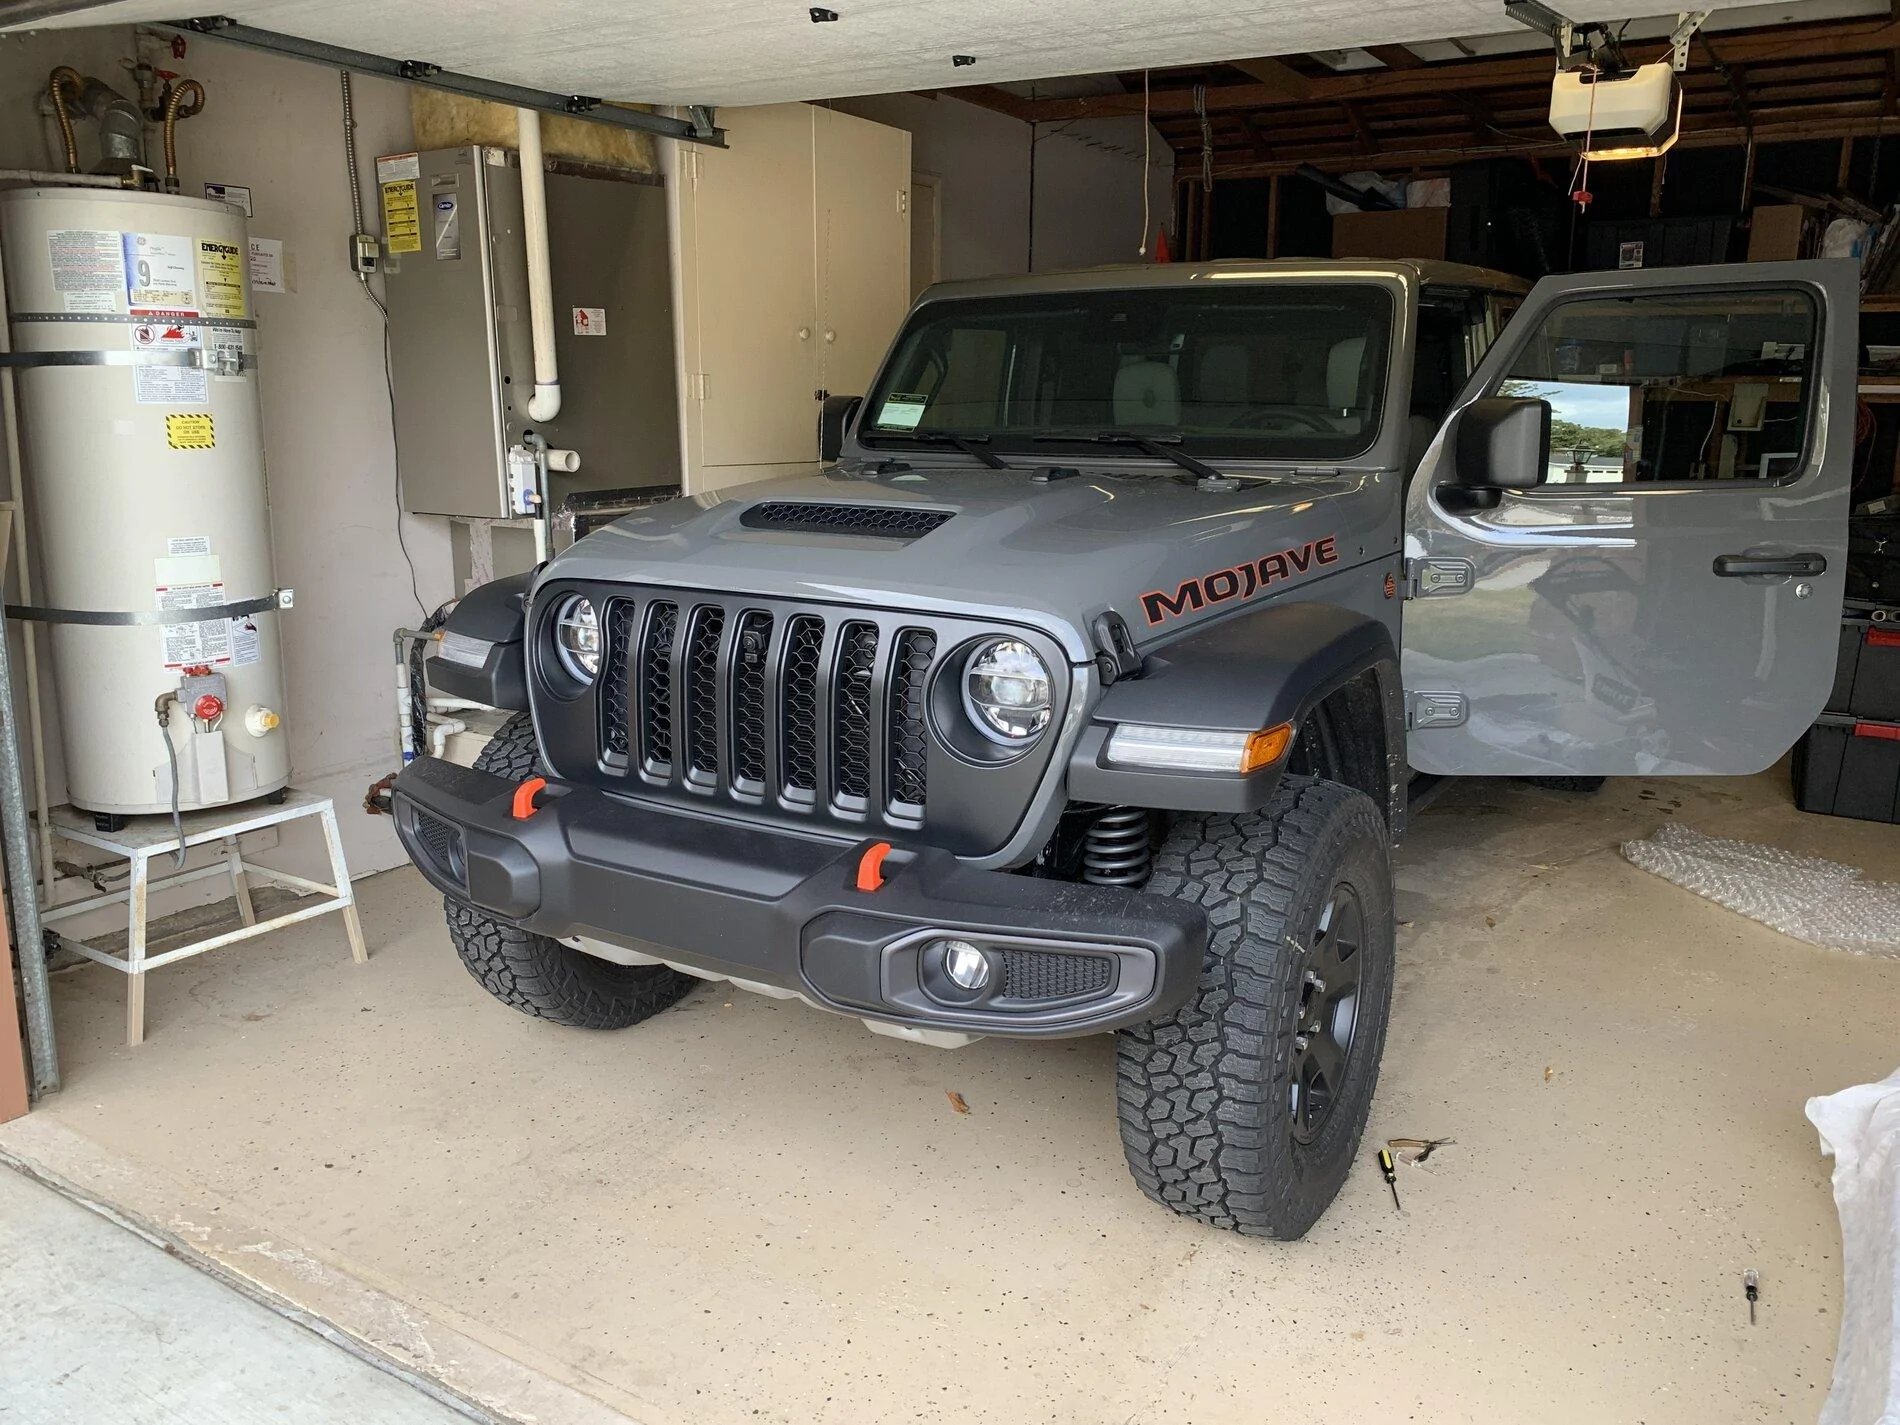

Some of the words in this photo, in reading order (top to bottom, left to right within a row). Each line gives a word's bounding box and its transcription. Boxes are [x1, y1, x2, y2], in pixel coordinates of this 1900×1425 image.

[384, 183, 414, 194] ENERGYGUIDE
[201, 242, 239, 256] ENERGYGUIDE
[138, 259, 151, 287] 9
[1138, 534, 1339, 626] MOJAVE
